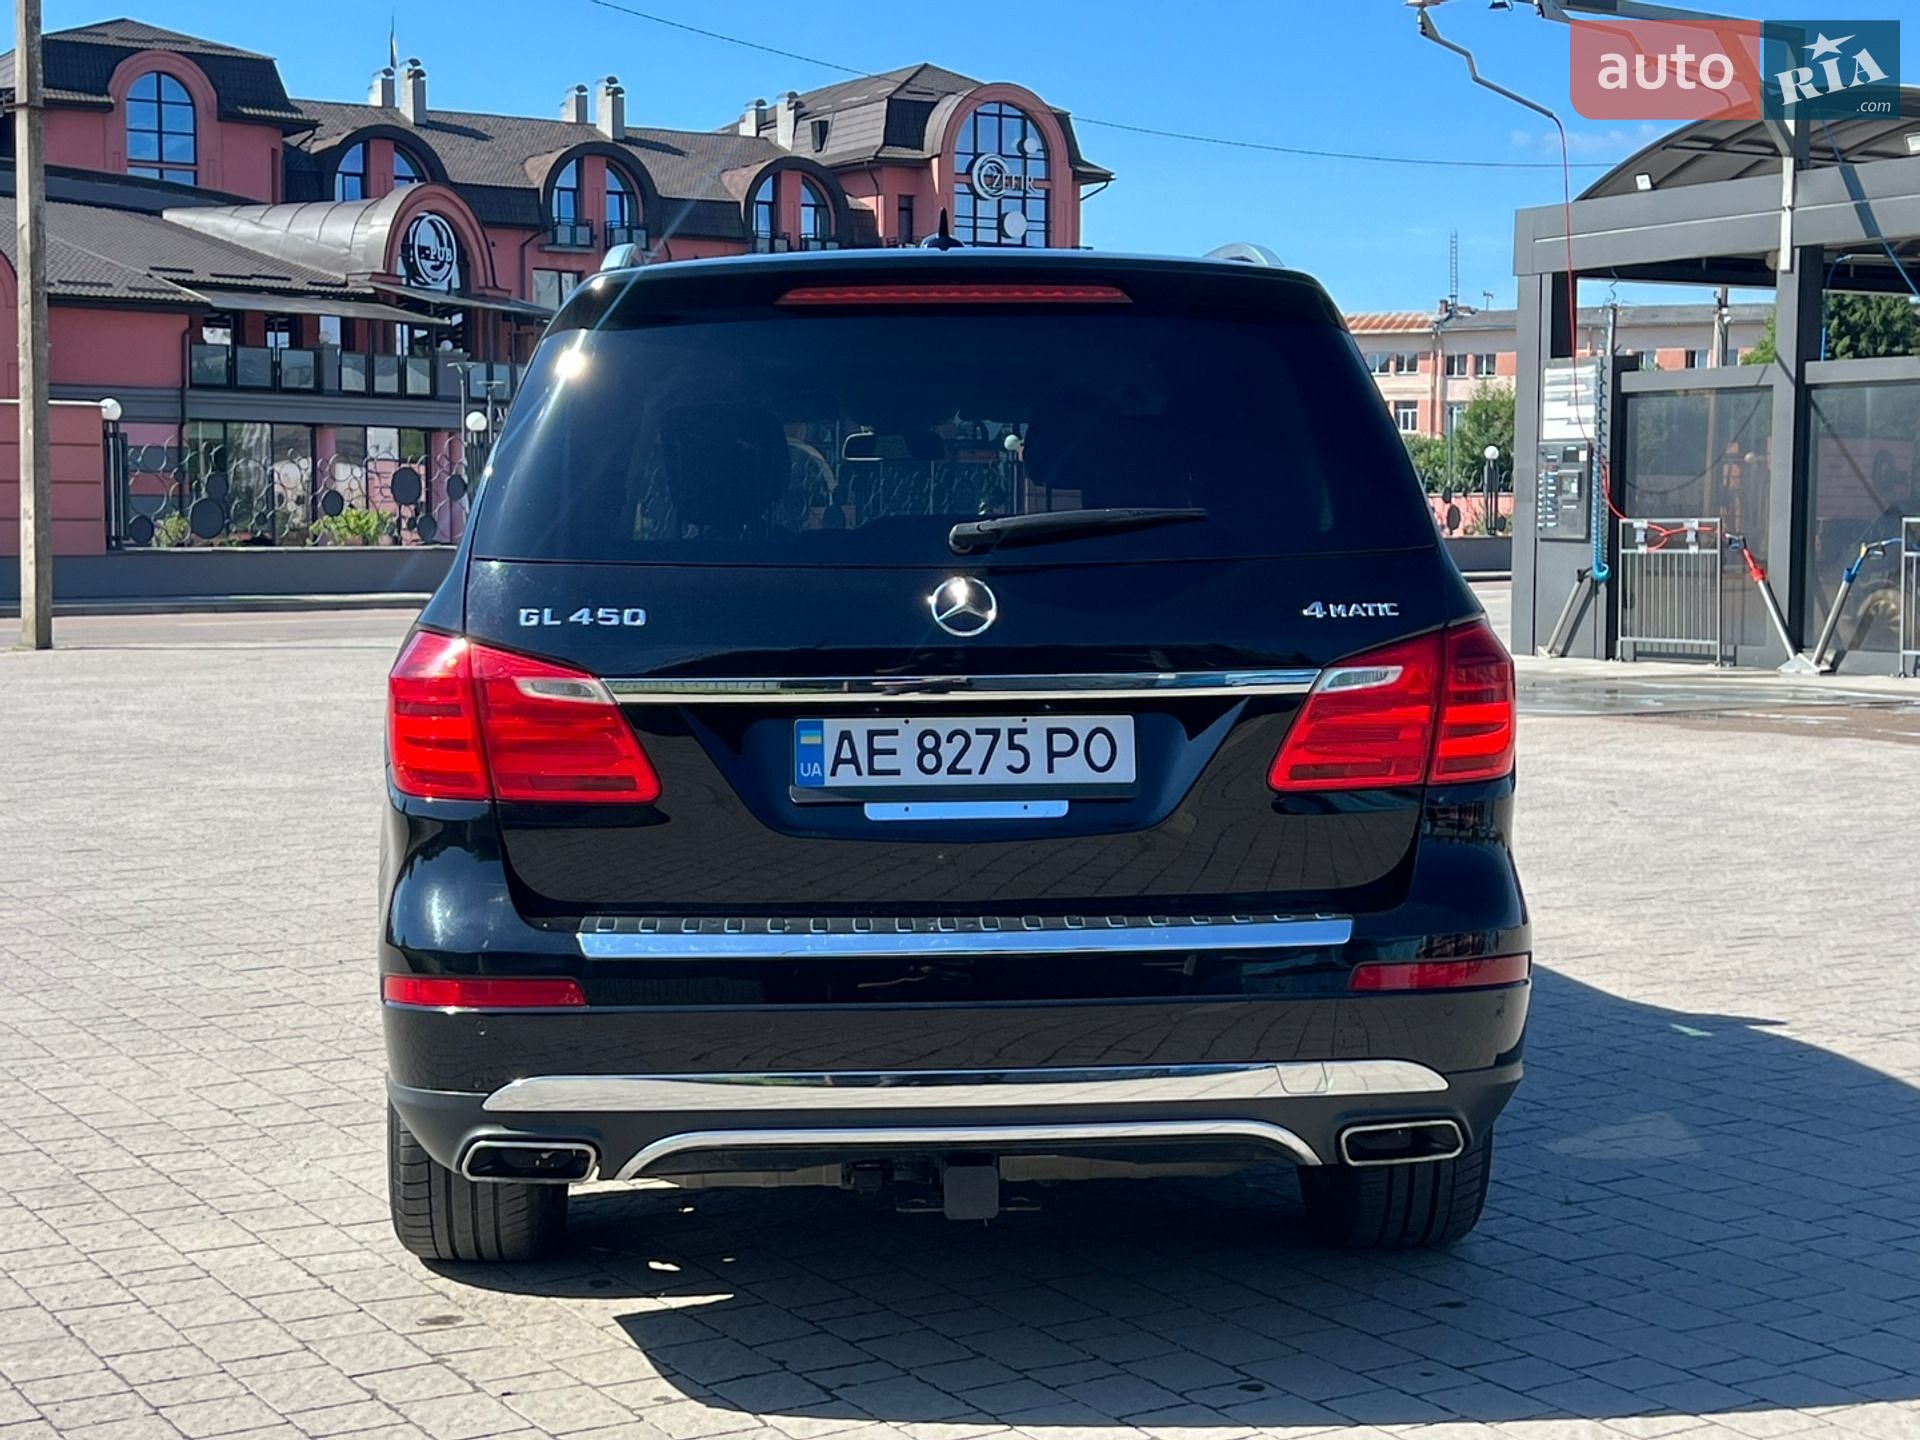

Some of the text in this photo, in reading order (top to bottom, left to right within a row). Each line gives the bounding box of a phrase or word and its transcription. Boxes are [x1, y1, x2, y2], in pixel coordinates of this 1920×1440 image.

[519, 607, 648, 626] GL 450
[830, 727, 1118, 777] AE 8275 PO
[800, 762, 823, 777] UA
